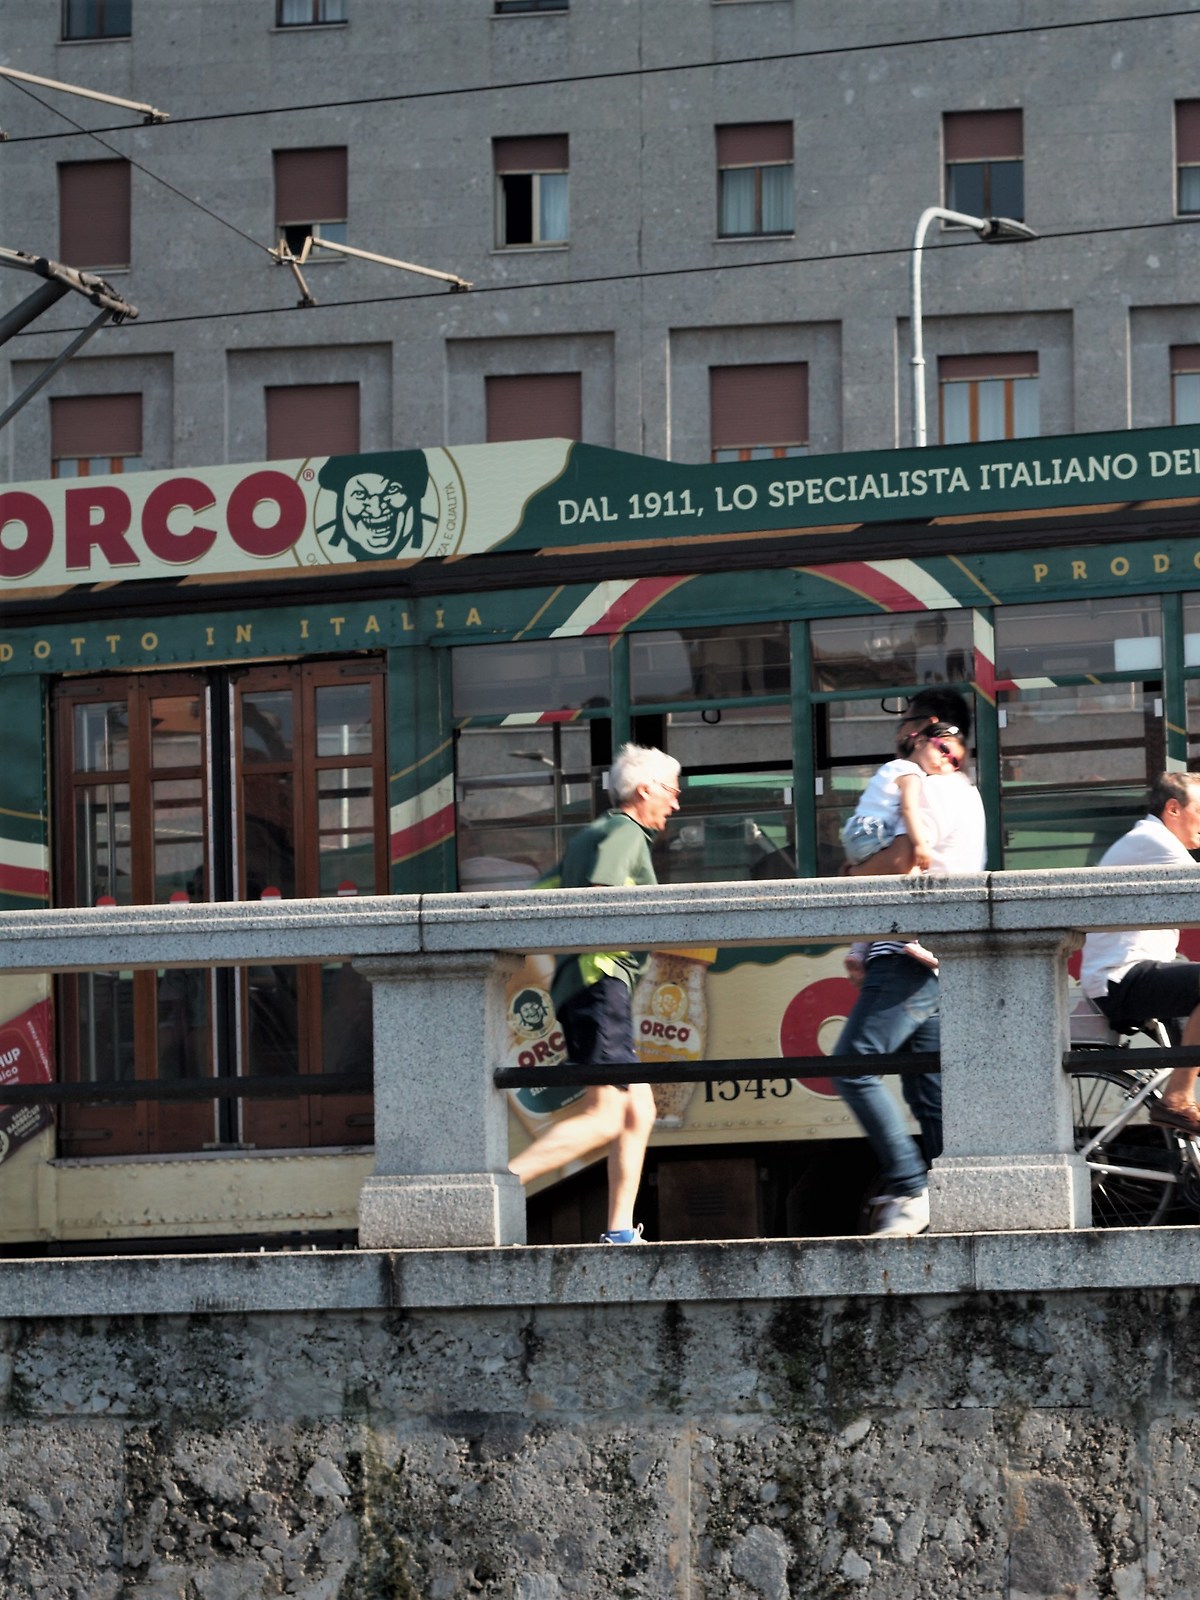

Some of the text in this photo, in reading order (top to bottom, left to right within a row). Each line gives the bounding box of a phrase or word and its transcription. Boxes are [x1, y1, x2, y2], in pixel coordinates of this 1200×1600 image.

[558, 496, 619, 525] DAL
[628, 489, 704, 520] 1911,
[715, 484, 758, 512] LO
[768, 466, 970, 508] SPECIALISTA
[979, 452, 1139, 491] ITALIANO
[0, 469, 307, 580] ORCO
[0, 607, 483, 662] DOTTO IN ITALIA
[518, 1031, 566, 1067] ORC
[640, 1019, 690, 1042] ORCO
